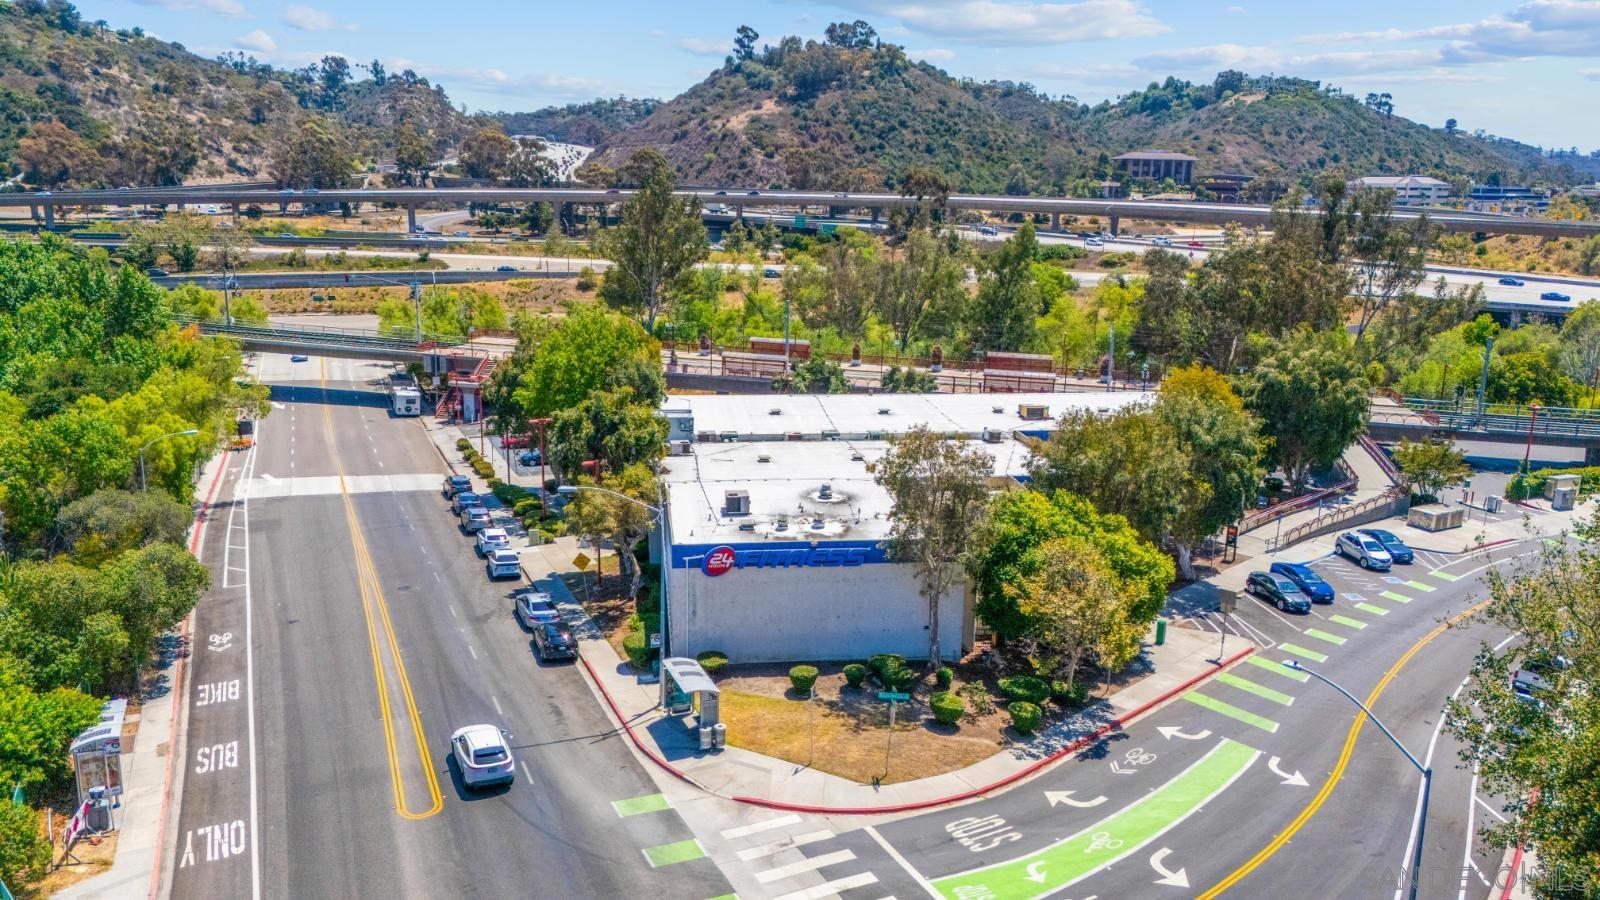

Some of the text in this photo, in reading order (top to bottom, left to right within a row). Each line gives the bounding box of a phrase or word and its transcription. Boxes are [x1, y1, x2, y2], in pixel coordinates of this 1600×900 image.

[710, 553, 734, 567] 24
[738, 549, 865, 569] FITNESS
[196, 679, 240, 706] BIKE
[195, 740, 238, 774] BUS
[180, 820, 246, 868] ONLY
[945, 814, 1023, 852] STOP
